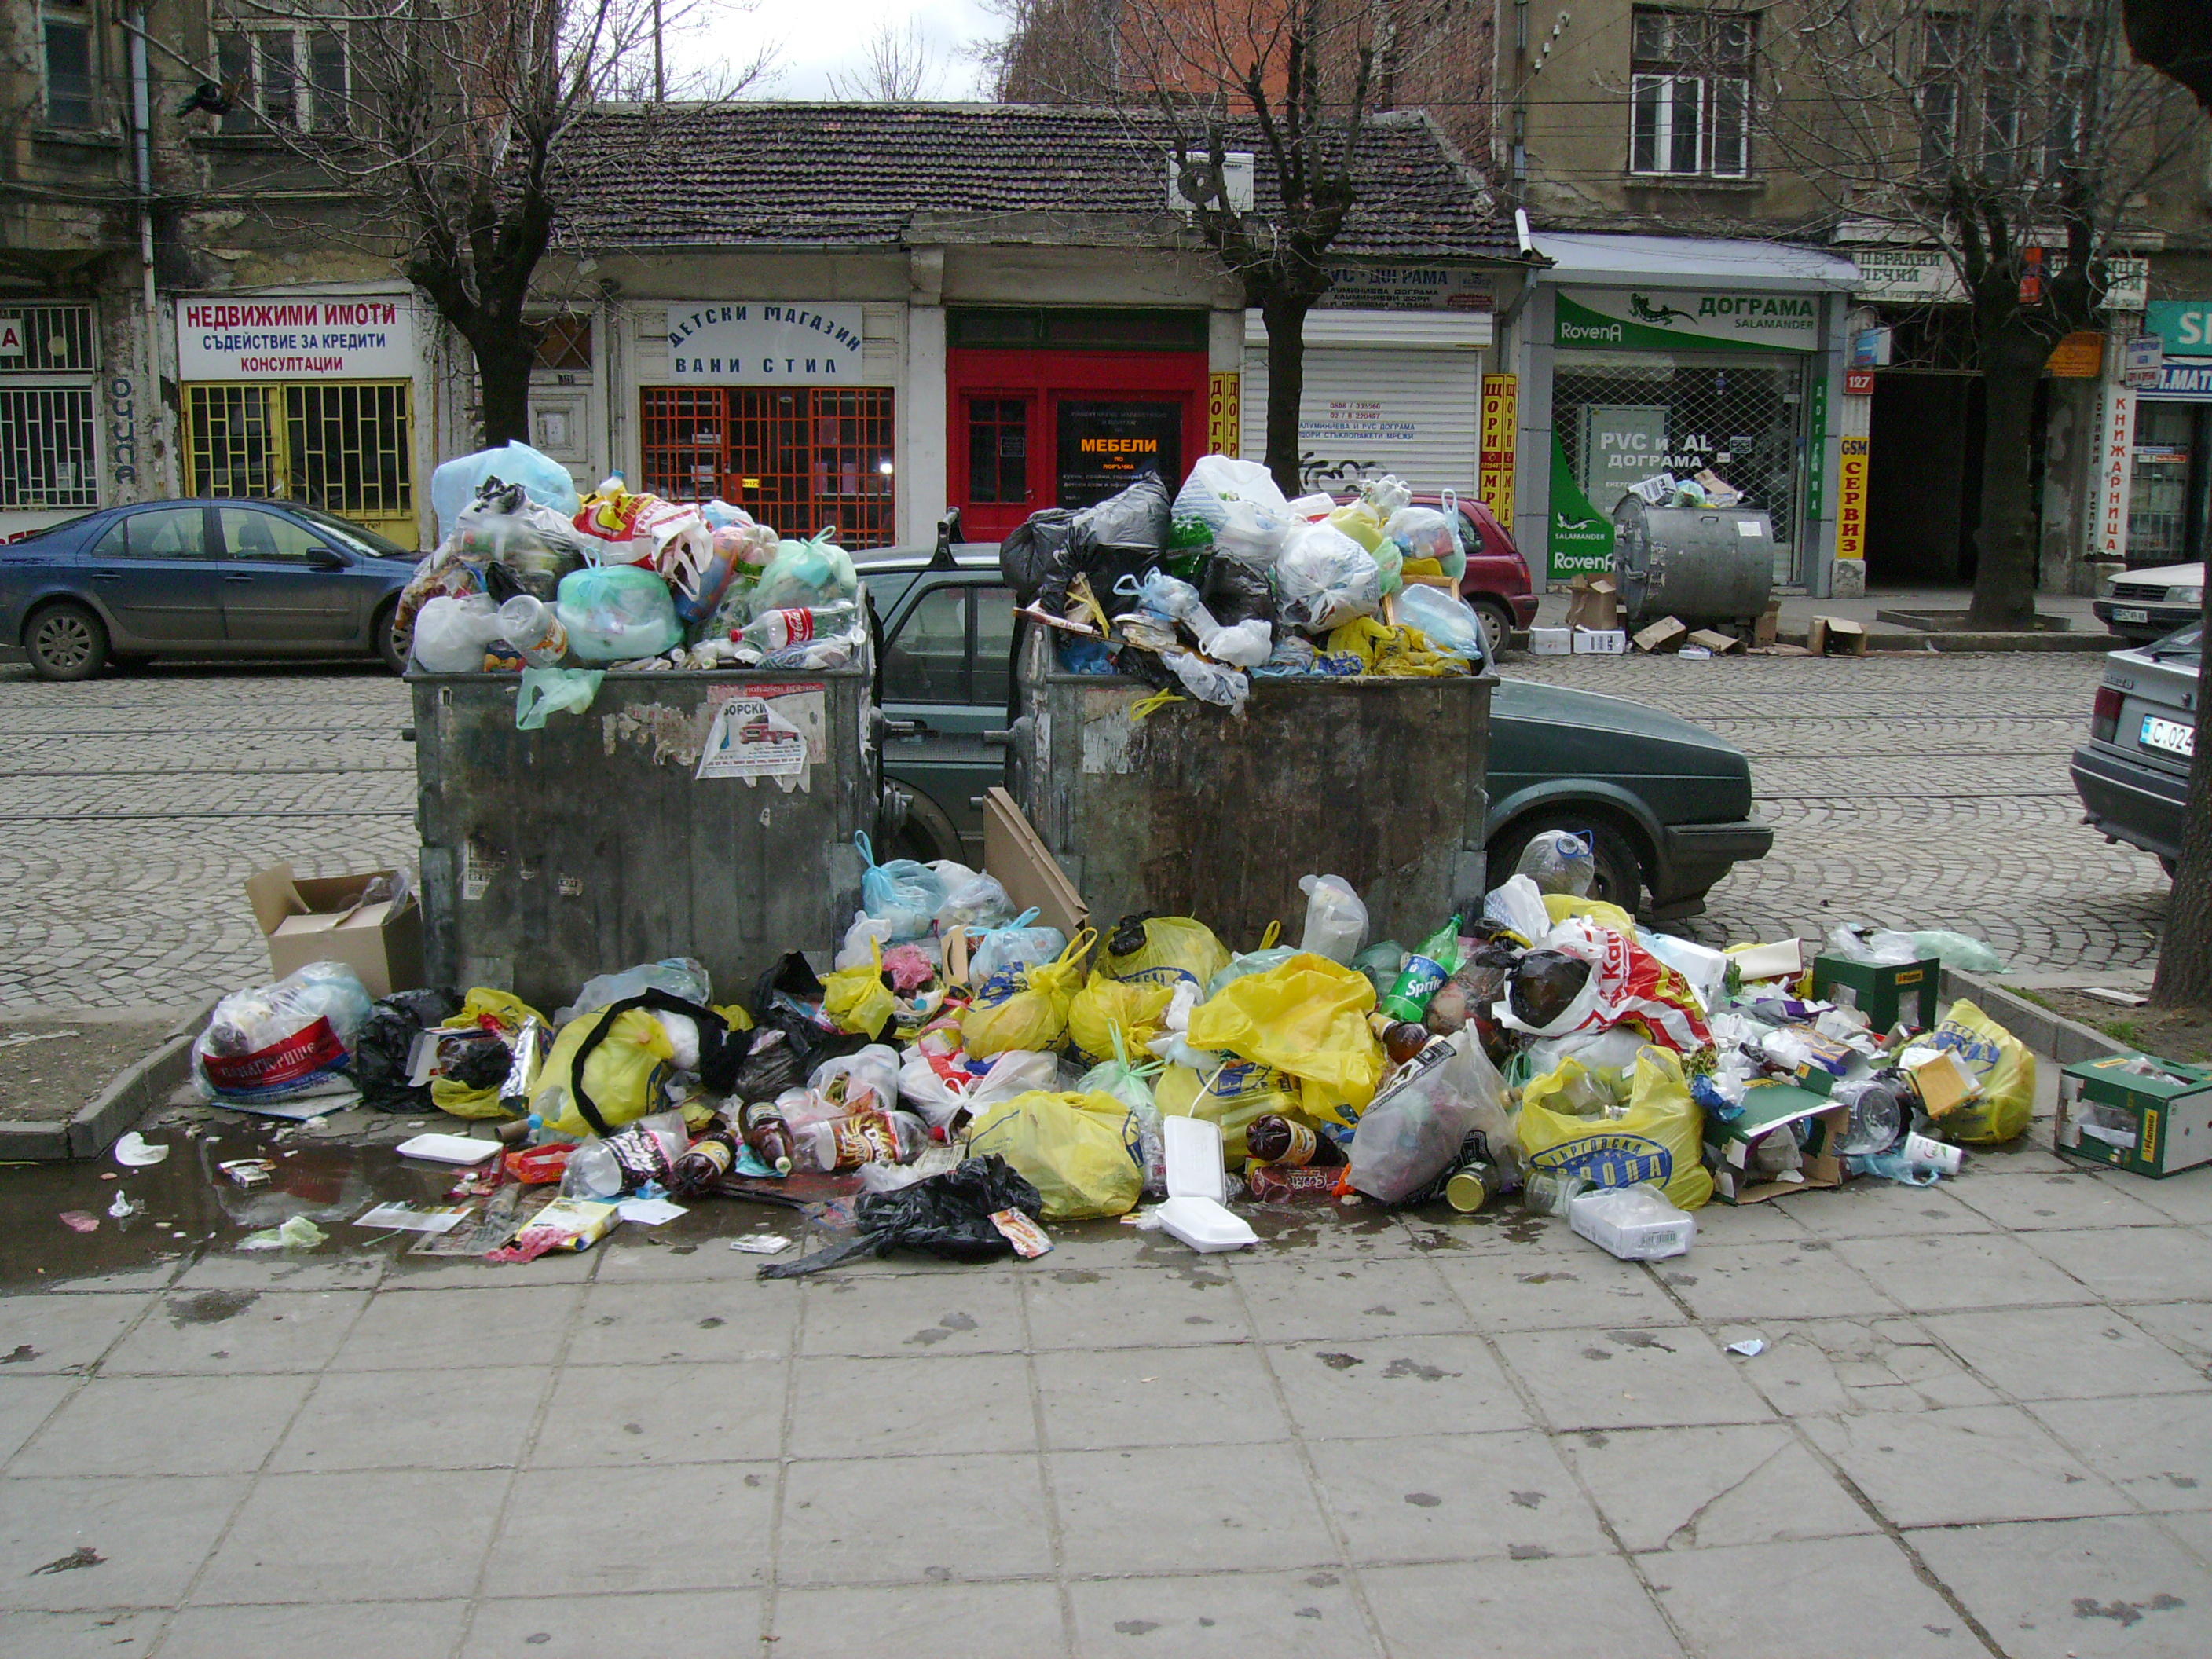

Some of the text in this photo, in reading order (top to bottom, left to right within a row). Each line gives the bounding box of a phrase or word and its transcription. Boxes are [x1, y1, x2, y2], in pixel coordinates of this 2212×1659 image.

[1322, 269, 1356, 284] VC
[187, 303, 396, 331] НЕДВИЖИМИ ИМОТИ
[1698, 297, 1814, 317] ДОГРАМА
[668, 306, 861, 352] ДЕТСКИ МАГАЗИН
[1734, 319, 1814, 329] SALAMANDER
[203, 332, 386, 352] СЪДЕЙСТВИЕ ЗА КРЕДИТИ
[240, 357, 343, 373] КОНСУЛТАЦИИ
[676, 358, 836, 373] ВАНИ СТИЛ
[1848, 376, 1870, 388] 127
[1485, 383, 1502, 448] ЩОРИ
[1081, 438, 1157, 452] МЕБЕЛИ
[1601, 433, 1647, 450] PVC
[1683, 434, 1713, 452] AL
[1811, 386, 1822, 511] ДОГРАМА
[1841, 440, 1867, 456] GSM
[1608, 454, 1702, 469] ДОГРАМА
[2106, 398, 2126, 550] КНИЖАРНИЦА
[1842, 462, 1862, 552] СЕРВИЗ
[724, 704, 767, 716] ОРСКИ
[1405, 977, 1444, 998] Sprite
[1549, 1138, 1642, 1166] ТЪРГОВСКА
[1536, 1155, 1662, 1186] РОПА
